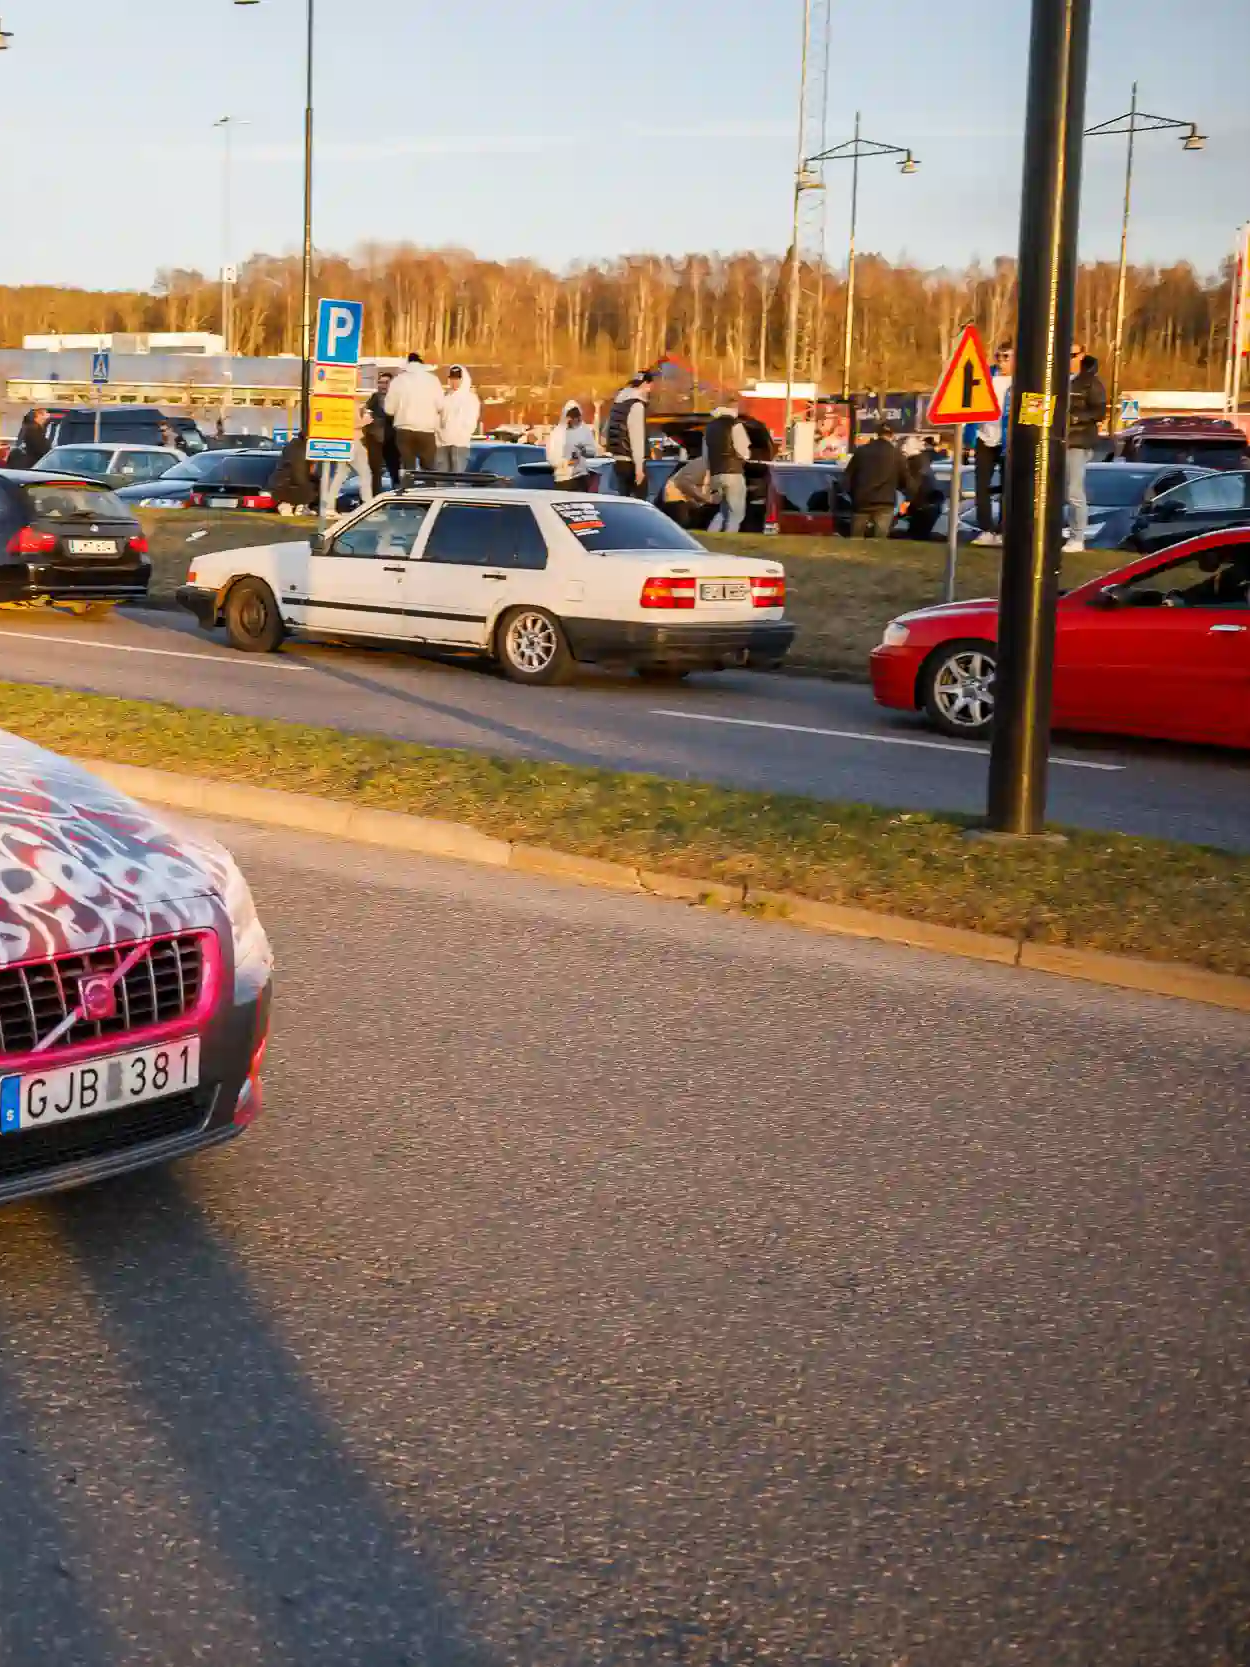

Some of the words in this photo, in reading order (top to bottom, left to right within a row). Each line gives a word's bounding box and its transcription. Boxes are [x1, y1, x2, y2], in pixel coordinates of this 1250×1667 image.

[328, 308, 354, 357] P
[27, 1069, 99, 1118] GJB
[130, 1046, 190, 1096] 381
